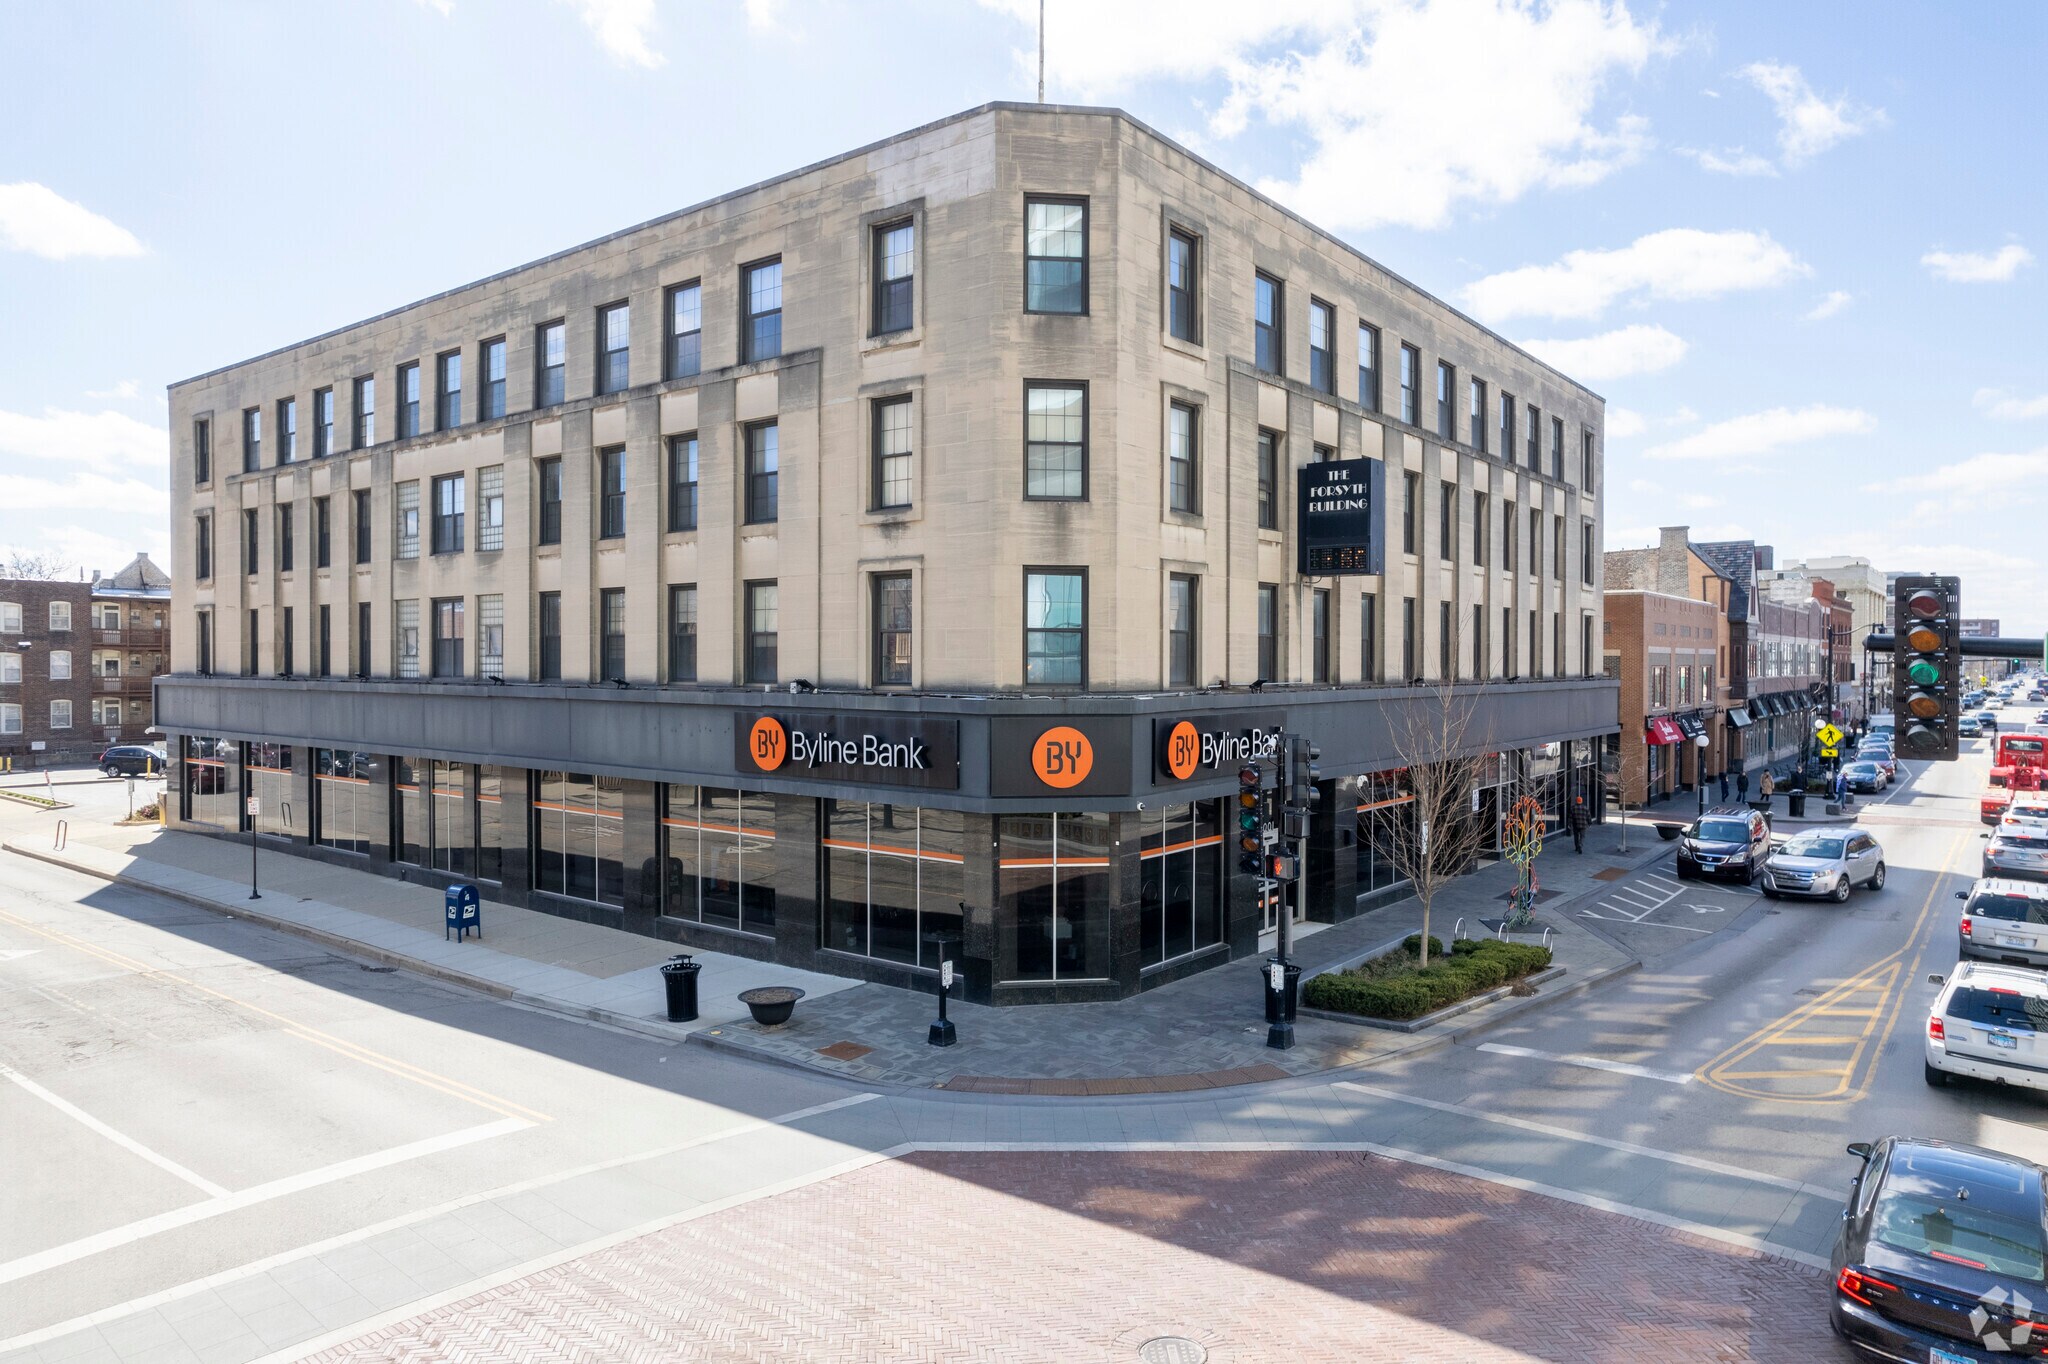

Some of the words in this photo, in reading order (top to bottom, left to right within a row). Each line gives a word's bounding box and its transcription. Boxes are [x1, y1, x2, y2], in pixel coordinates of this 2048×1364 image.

[1310, 483, 1367, 498] FORSYTH
[1328, 469, 1350, 481] THE
[1309, 498, 1368, 513] BUILDING
[757, 729, 779, 759] BY
[791, 731, 858, 769] Byline
[863, 734, 924, 770] Bank
[1046, 741, 1082, 775] BY
[1175, 735, 1194, 767] BY
[1202, 731, 1250, 770] Byline
